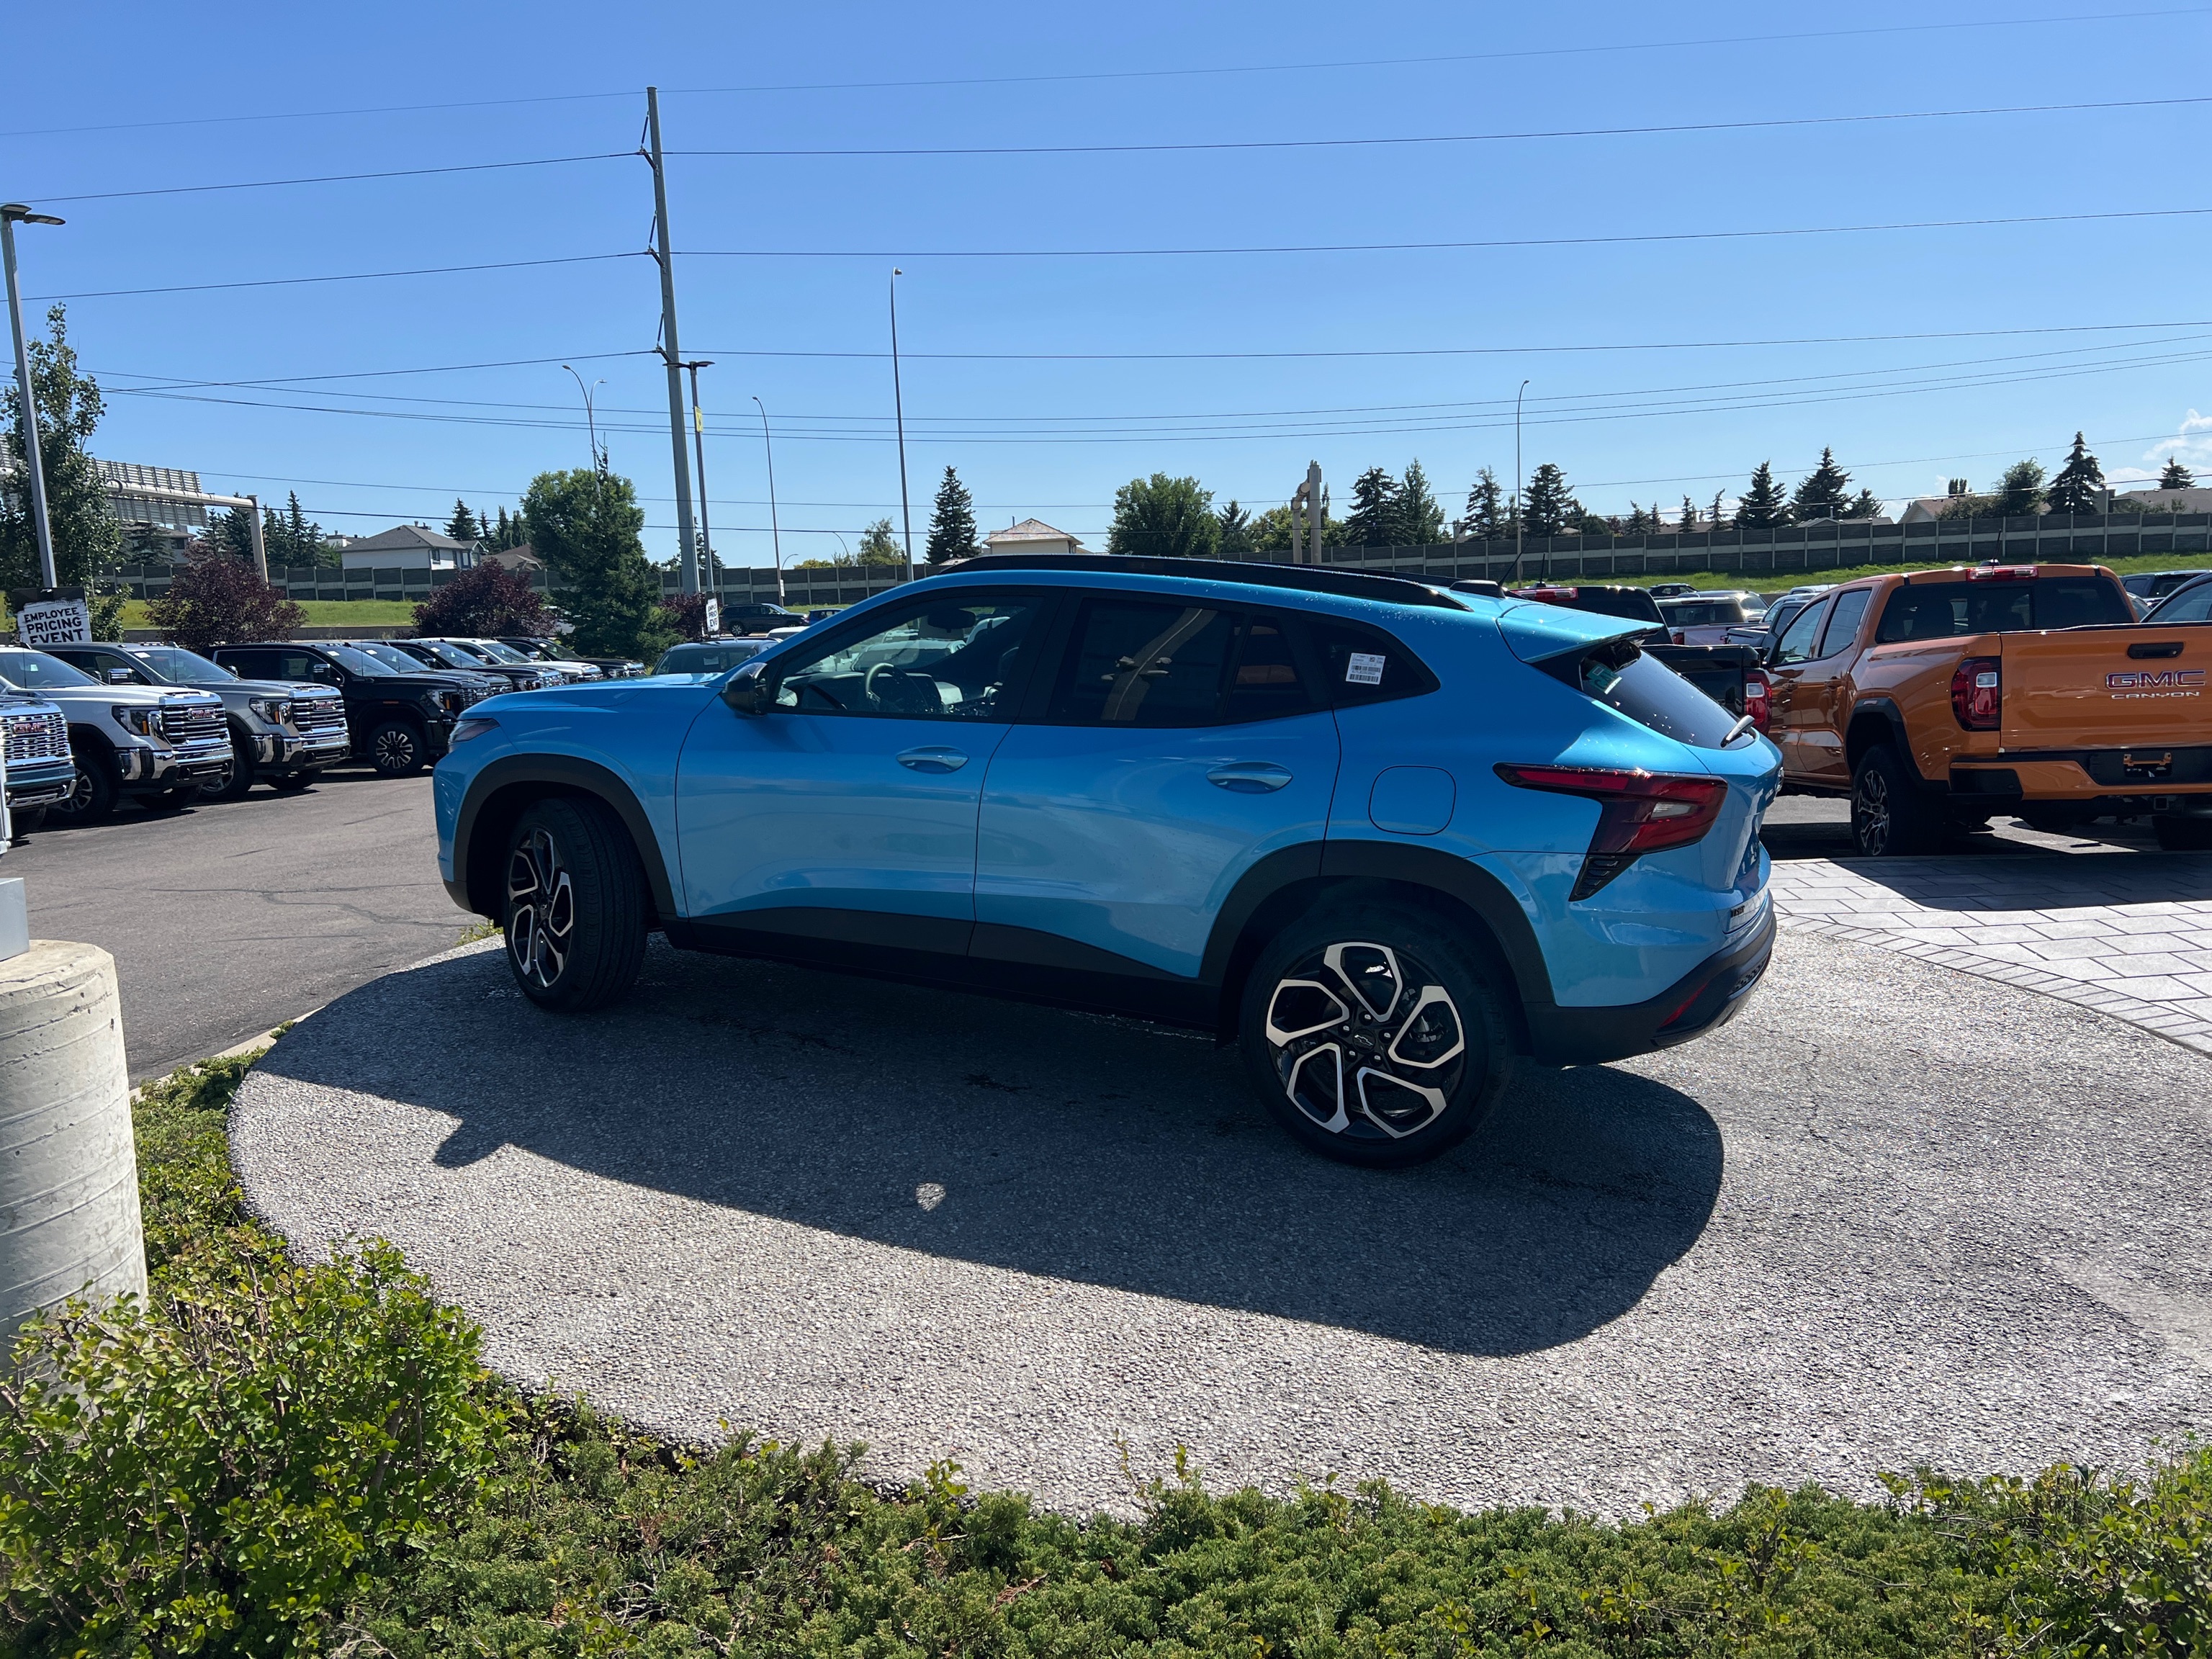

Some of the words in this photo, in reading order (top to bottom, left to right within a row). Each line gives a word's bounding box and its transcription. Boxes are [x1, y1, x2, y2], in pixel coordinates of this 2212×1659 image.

[24, 607, 78, 623] EMPLOYEE
[26, 616, 82, 634] PRICING
[30, 628, 84, 644] EVENT
[2105, 670, 2206, 689] GMC
[2110, 691, 2200, 700] CANYON
[14, 721, 48, 734] GMC
